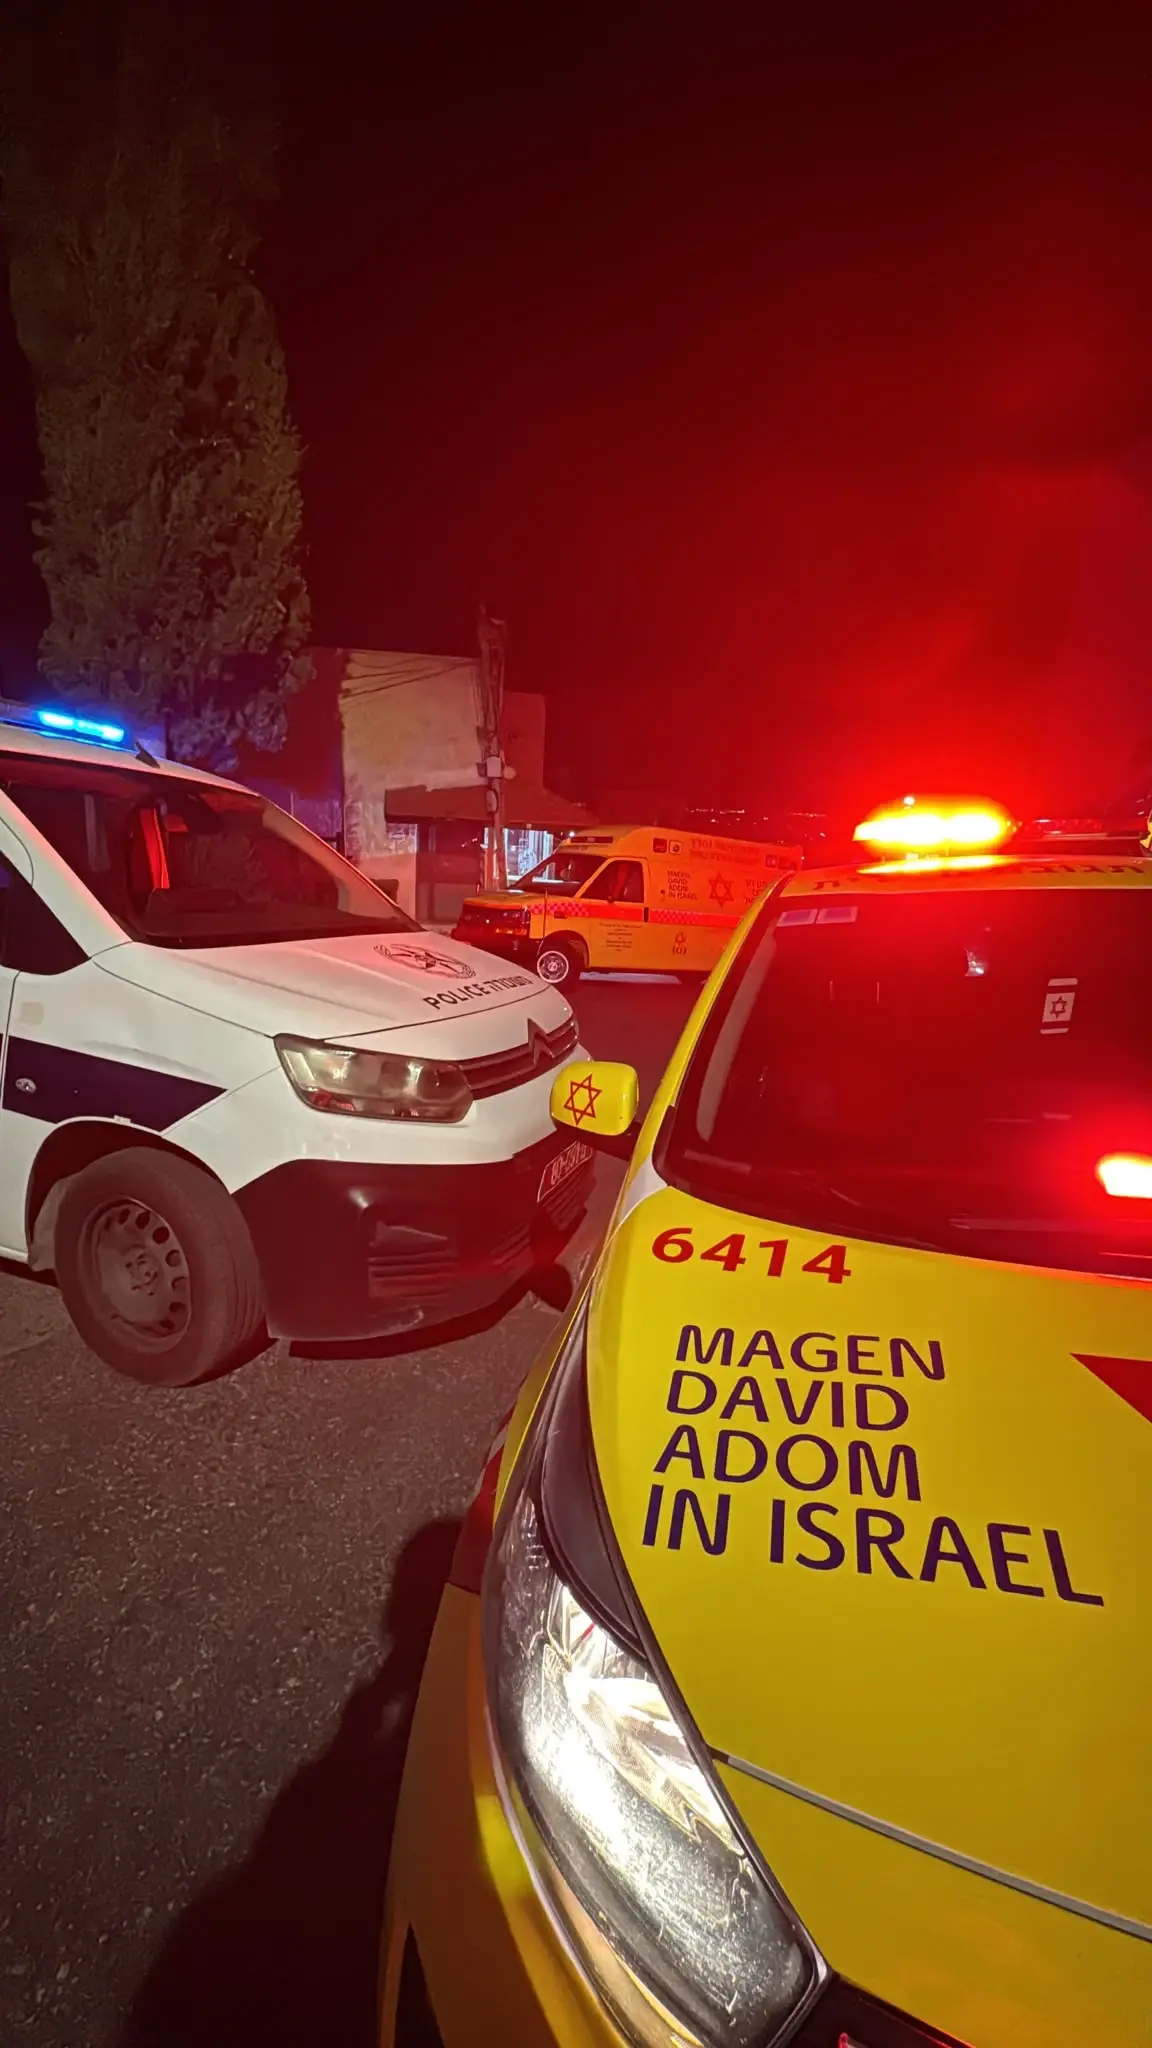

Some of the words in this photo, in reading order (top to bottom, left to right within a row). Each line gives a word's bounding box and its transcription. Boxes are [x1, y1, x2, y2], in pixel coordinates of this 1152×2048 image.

[422, 983, 491, 1010] POLICE
[651, 1227, 852, 1284] 6414
[675, 1324, 946, 1381] MAGEN
[666, 1369, 910, 1432] DAVID
[653, 1424, 922, 1502] ADOM
[642, 1484, 731, 1556] IN
[769, 1498, 1105, 1607] ISRAEL
